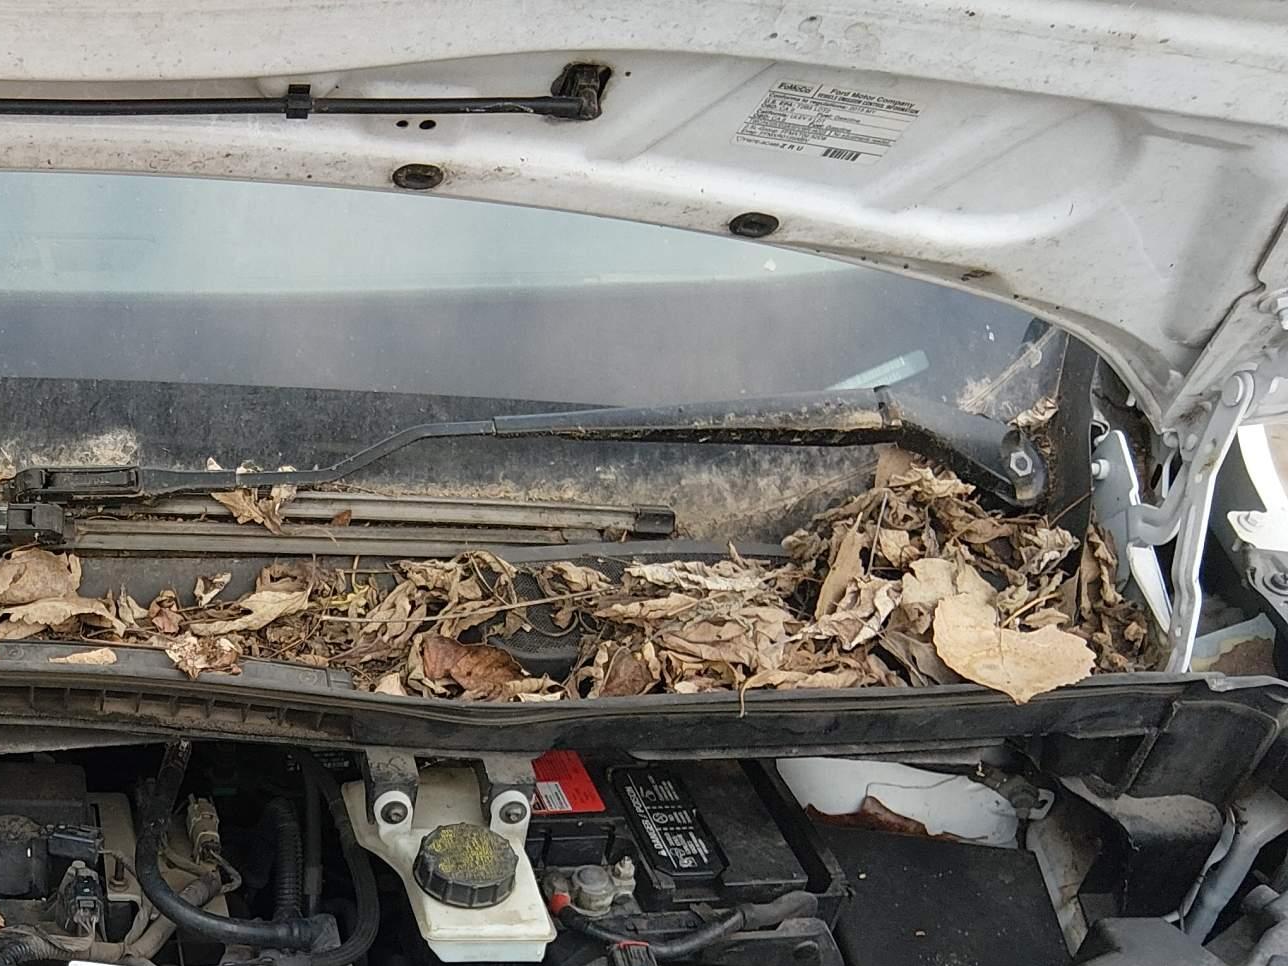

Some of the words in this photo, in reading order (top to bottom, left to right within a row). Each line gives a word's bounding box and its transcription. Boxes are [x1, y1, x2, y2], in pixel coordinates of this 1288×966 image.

[778, 82, 812, 94] FoMoCo
[830, 88, 851, 97] Ford
[851, 92, 876, 101] Motor
[877, 96, 916, 109] Company
[642, 819, 664, 850] DANGER
